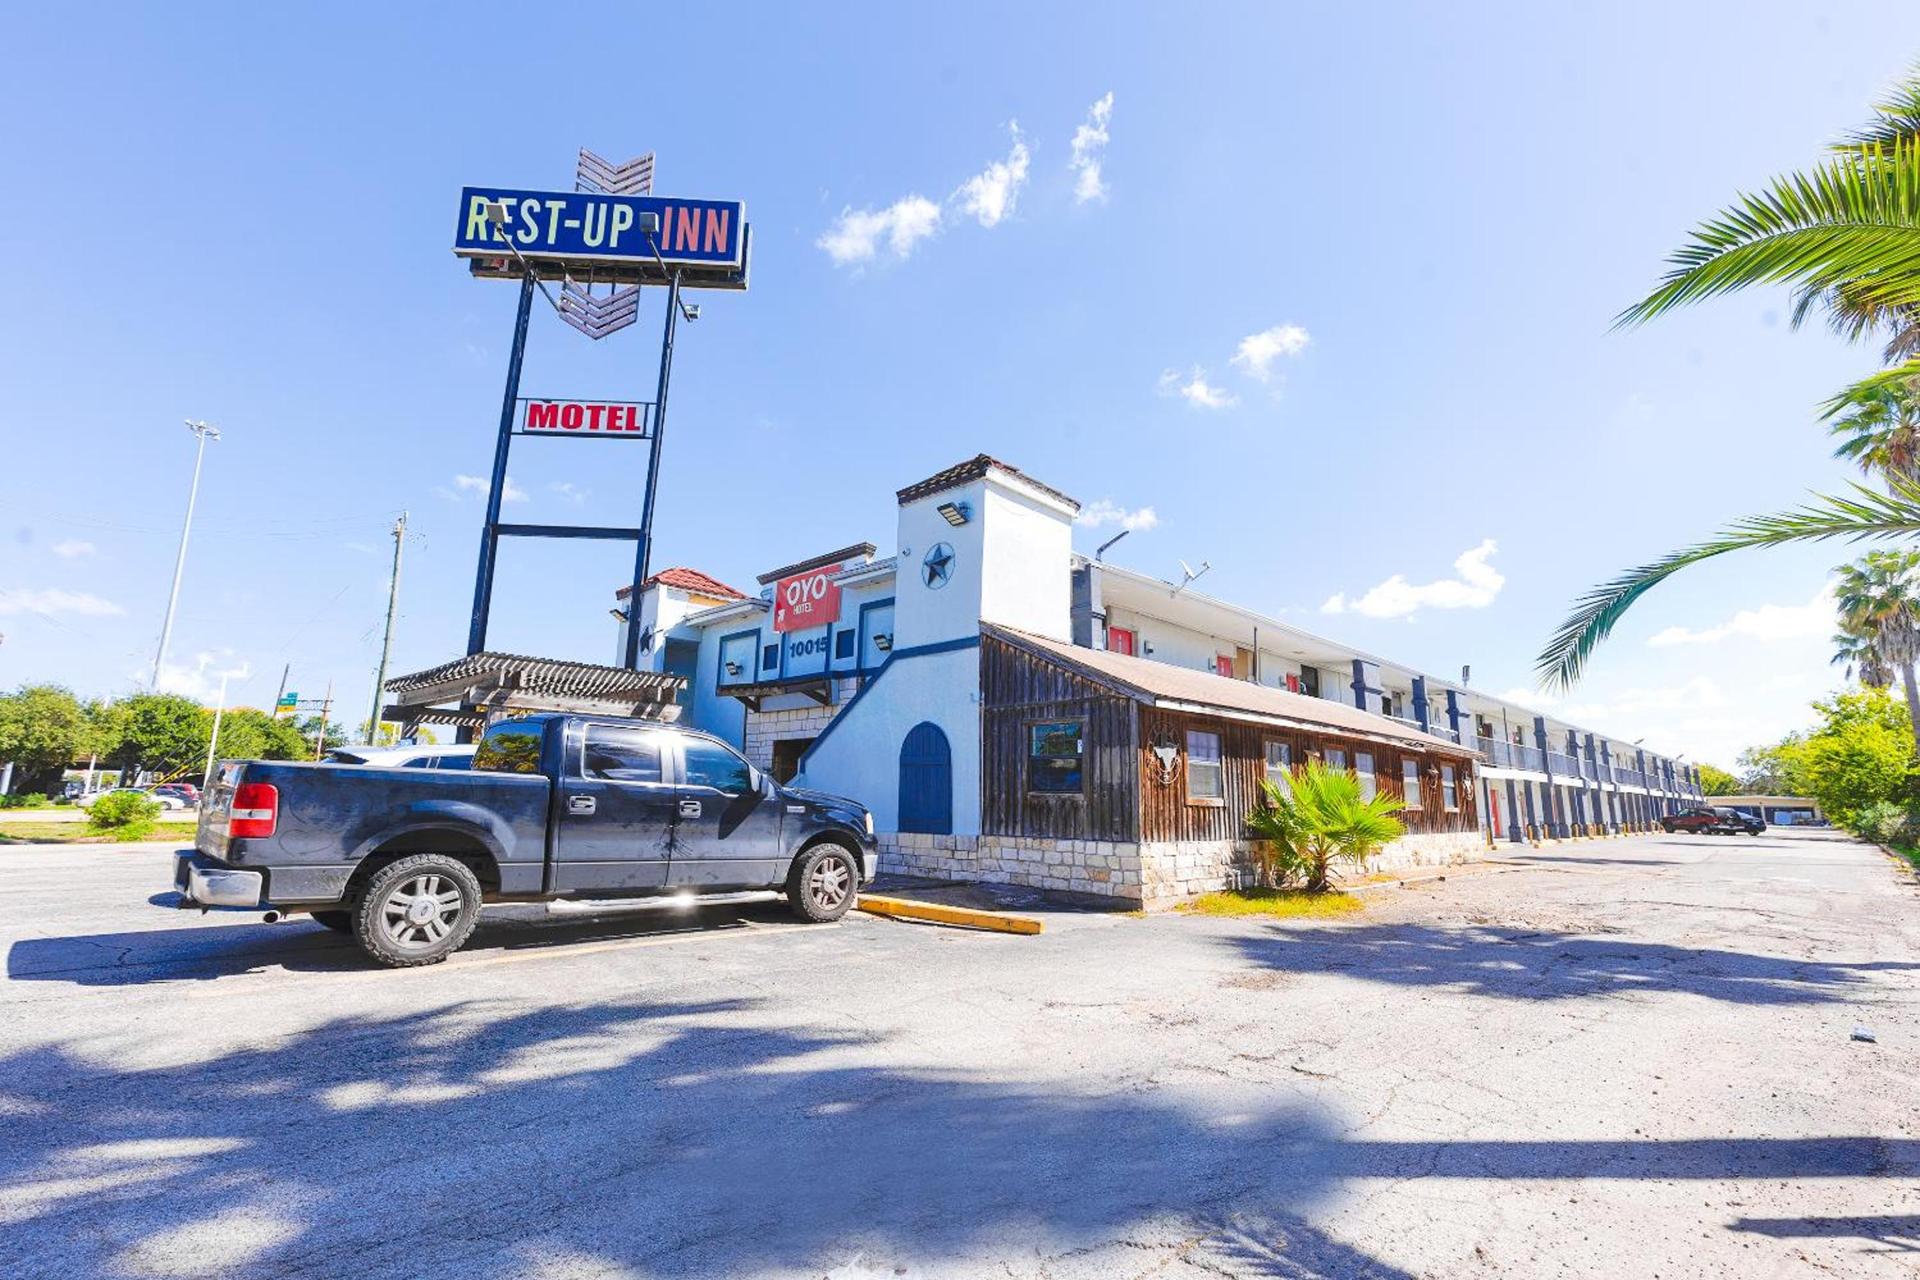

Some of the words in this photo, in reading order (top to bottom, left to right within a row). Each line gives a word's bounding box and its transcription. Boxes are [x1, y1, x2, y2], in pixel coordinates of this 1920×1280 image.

[466, 195, 634, 248] REST-UP
[661, 206, 730, 254] INN
[528, 403, 641, 431] MOTEL
[786, 574, 827, 606] OYO
[793, 602, 813, 616] HOTEL
[789, 636, 828, 658] 10015
